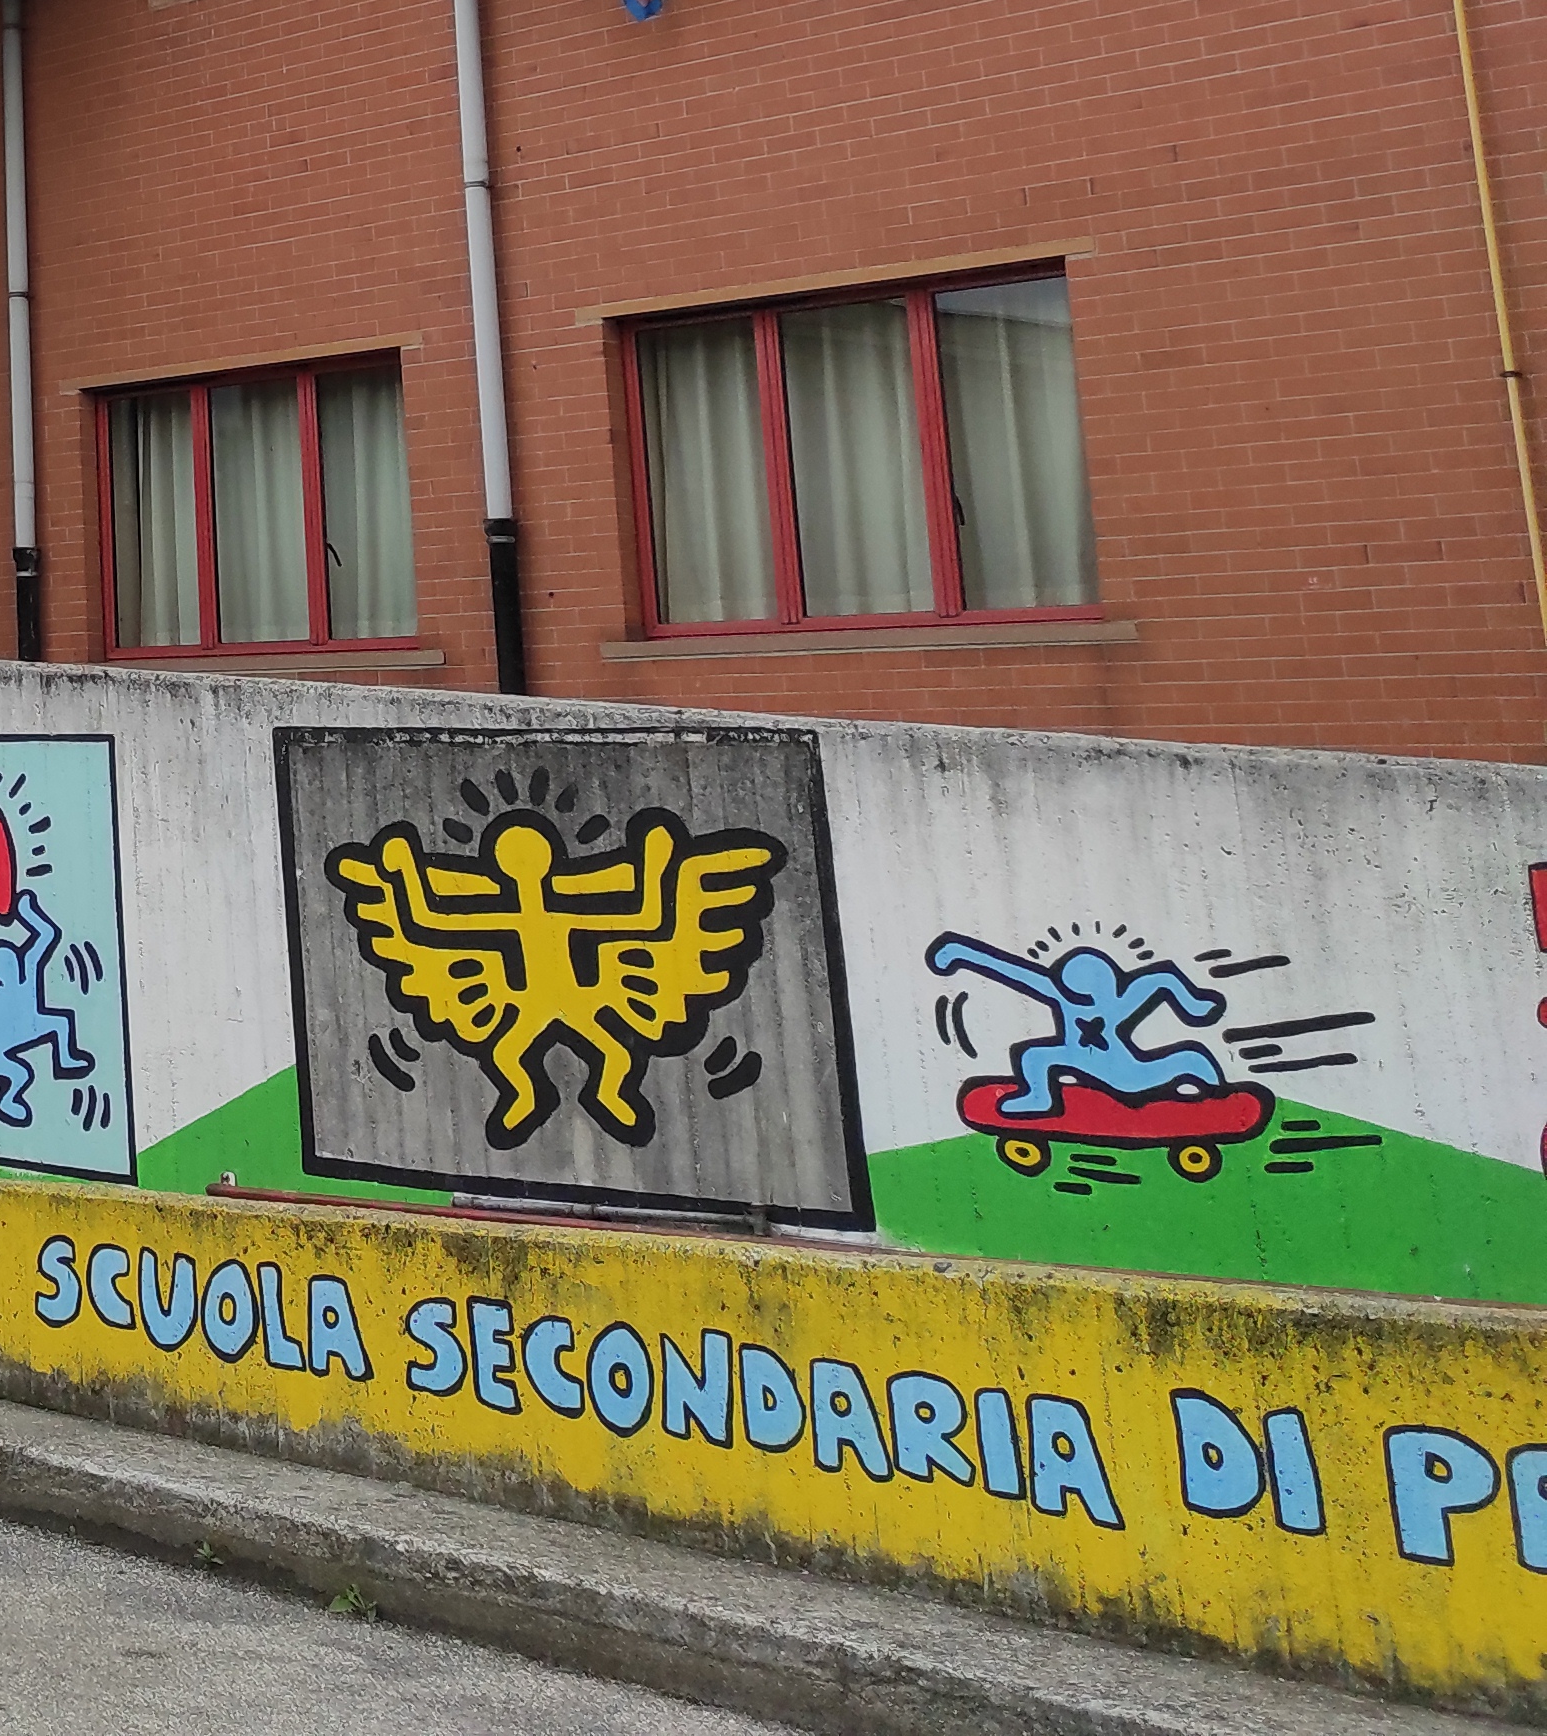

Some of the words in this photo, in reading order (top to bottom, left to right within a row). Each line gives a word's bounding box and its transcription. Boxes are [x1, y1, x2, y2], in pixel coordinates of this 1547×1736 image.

[34, 1234, 375, 1382] SCUOLA
[405, 1295, 1126, 1530] SECONDARIA
[1169, 1387, 1327, 1536] DI
